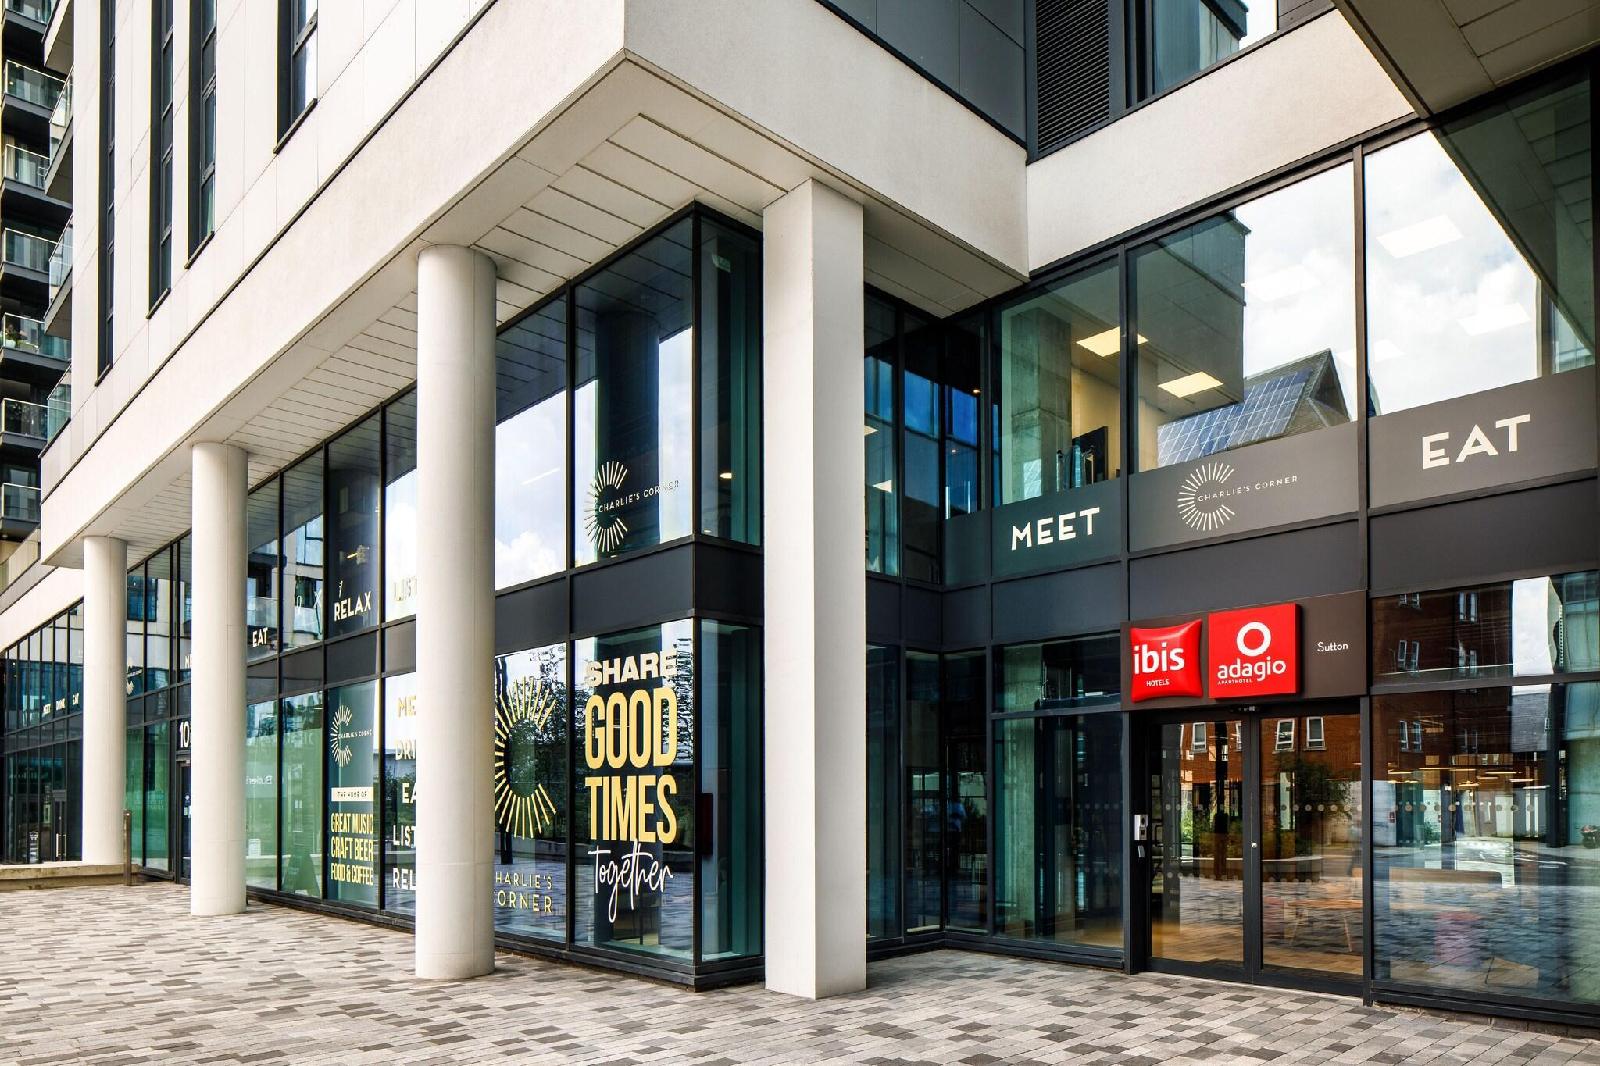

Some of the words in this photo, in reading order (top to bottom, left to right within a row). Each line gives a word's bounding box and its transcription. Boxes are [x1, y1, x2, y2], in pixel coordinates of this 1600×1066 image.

[1422, 413, 1531, 470] EAT
[1197, 485, 1250, 502] CHARLIE'S
[1254, 475, 1298, 490] CORNER
[598, 493, 640, 513] CHARLIE'S
[1011, 507, 1100, 551] MEET
[333, 591, 371, 621] RELAX
[252, 627, 268, 648] EAT
[1317, 641, 1349, 652] Sutton
[585, 650, 677, 687] SHARE
[1133, 642, 1185, 674] ibis
[1217, 656, 1286, 681] adagio
[1146, 678, 1170, 687] HOTELS
[397, 695, 416, 717] ME
[585, 687, 677, 769] GOOD
[395, 739, 416, 760] DRI
[402, 782, 416, 804] EA
[585, 774, 677, 843] TIMES
[331, 812, 351, 833] GREAT
[393, 824, 416, 848] LIST
[331, 836, 353, 859] CRAFT
[355, 838, 373, 862] BEER
[331, 862, 345, 881] FOOD
[351, 864, 373, 886] COFFEE
[393, 867, 416, 890] REL
[495, 871, 552, 890] HARLIE'S
[493, 889, 552, 913] ORNER
